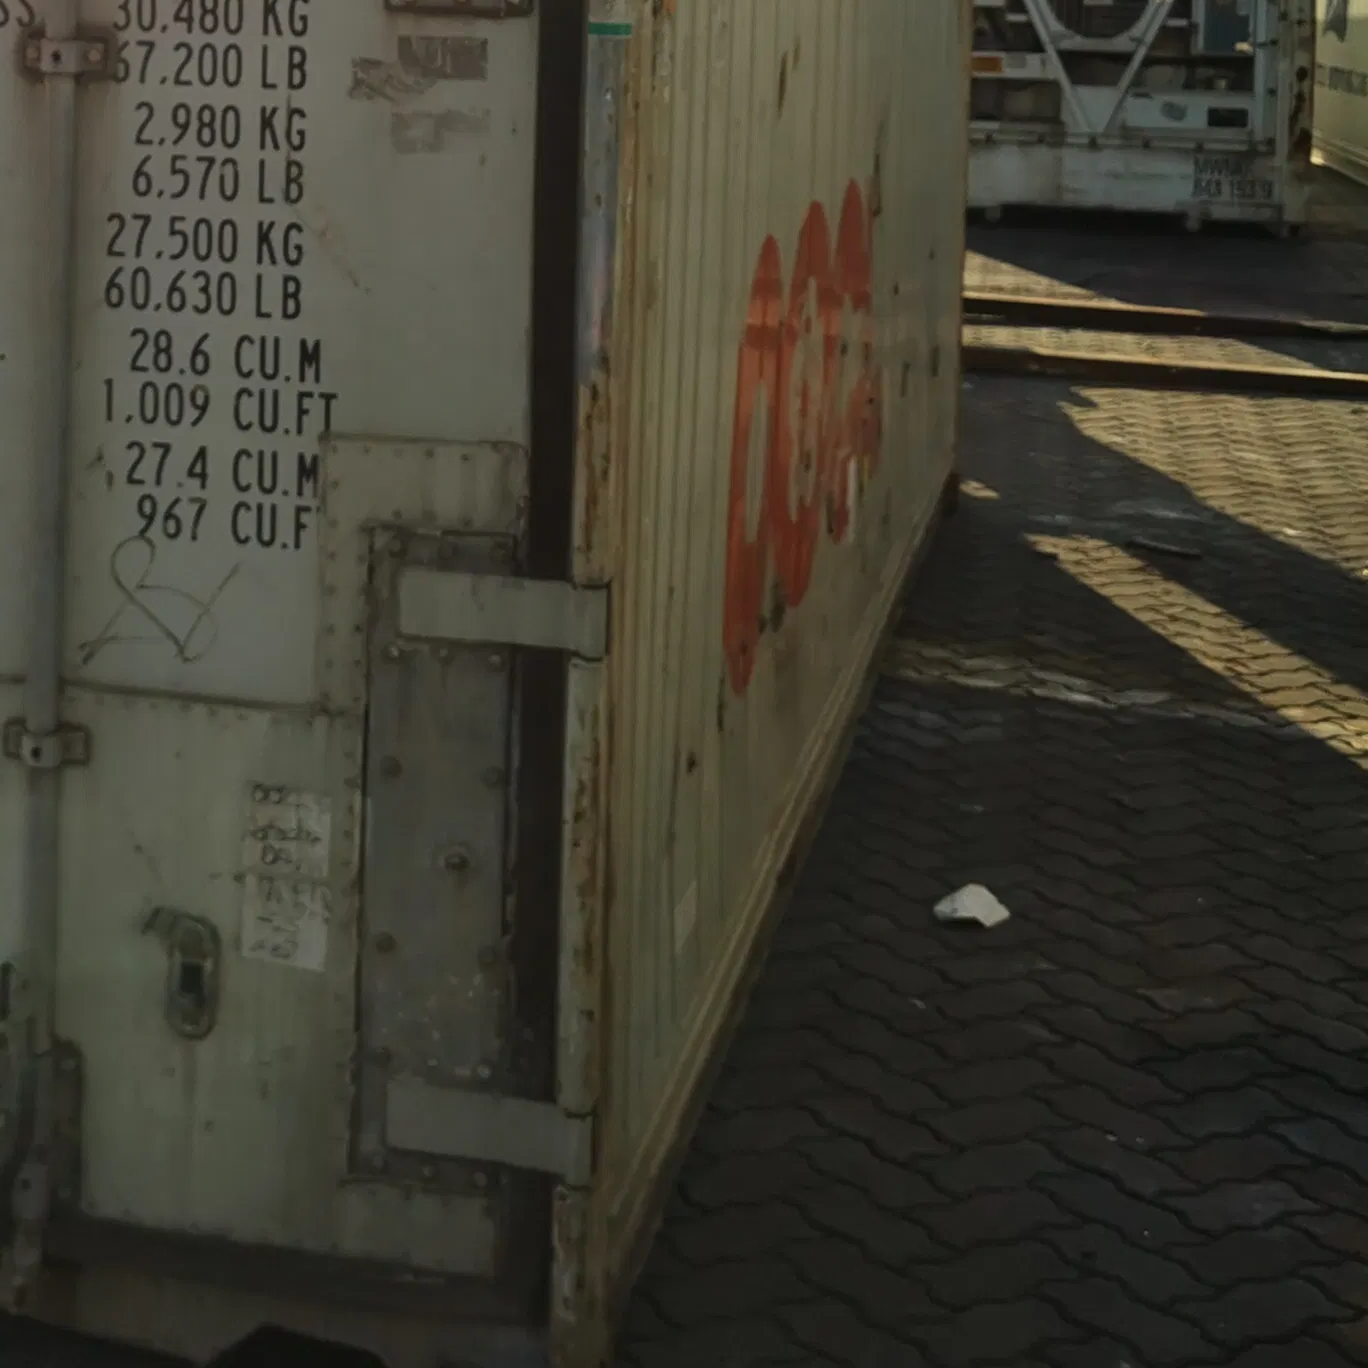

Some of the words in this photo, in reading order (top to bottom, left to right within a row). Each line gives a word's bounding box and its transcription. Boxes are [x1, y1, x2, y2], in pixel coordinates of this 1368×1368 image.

[260, 43, 308, 91] LB
[258, 104, 307, 152] KG
[258, 157, 305, 205] LB
[256, 220, 305, 267] KG
[254, 272, 302, 320] LB
[129, 327, 210, 377] 28.6
[234, 333, 322, 384] CU.M
[233, 386, 338, 436] CU.FT
[125, 440, 209, 491] 27.4
[231, 447, 320, 499] CU.M
[137, 492, 208, 543] 967
[230, 500, 321, 551] CU.F
